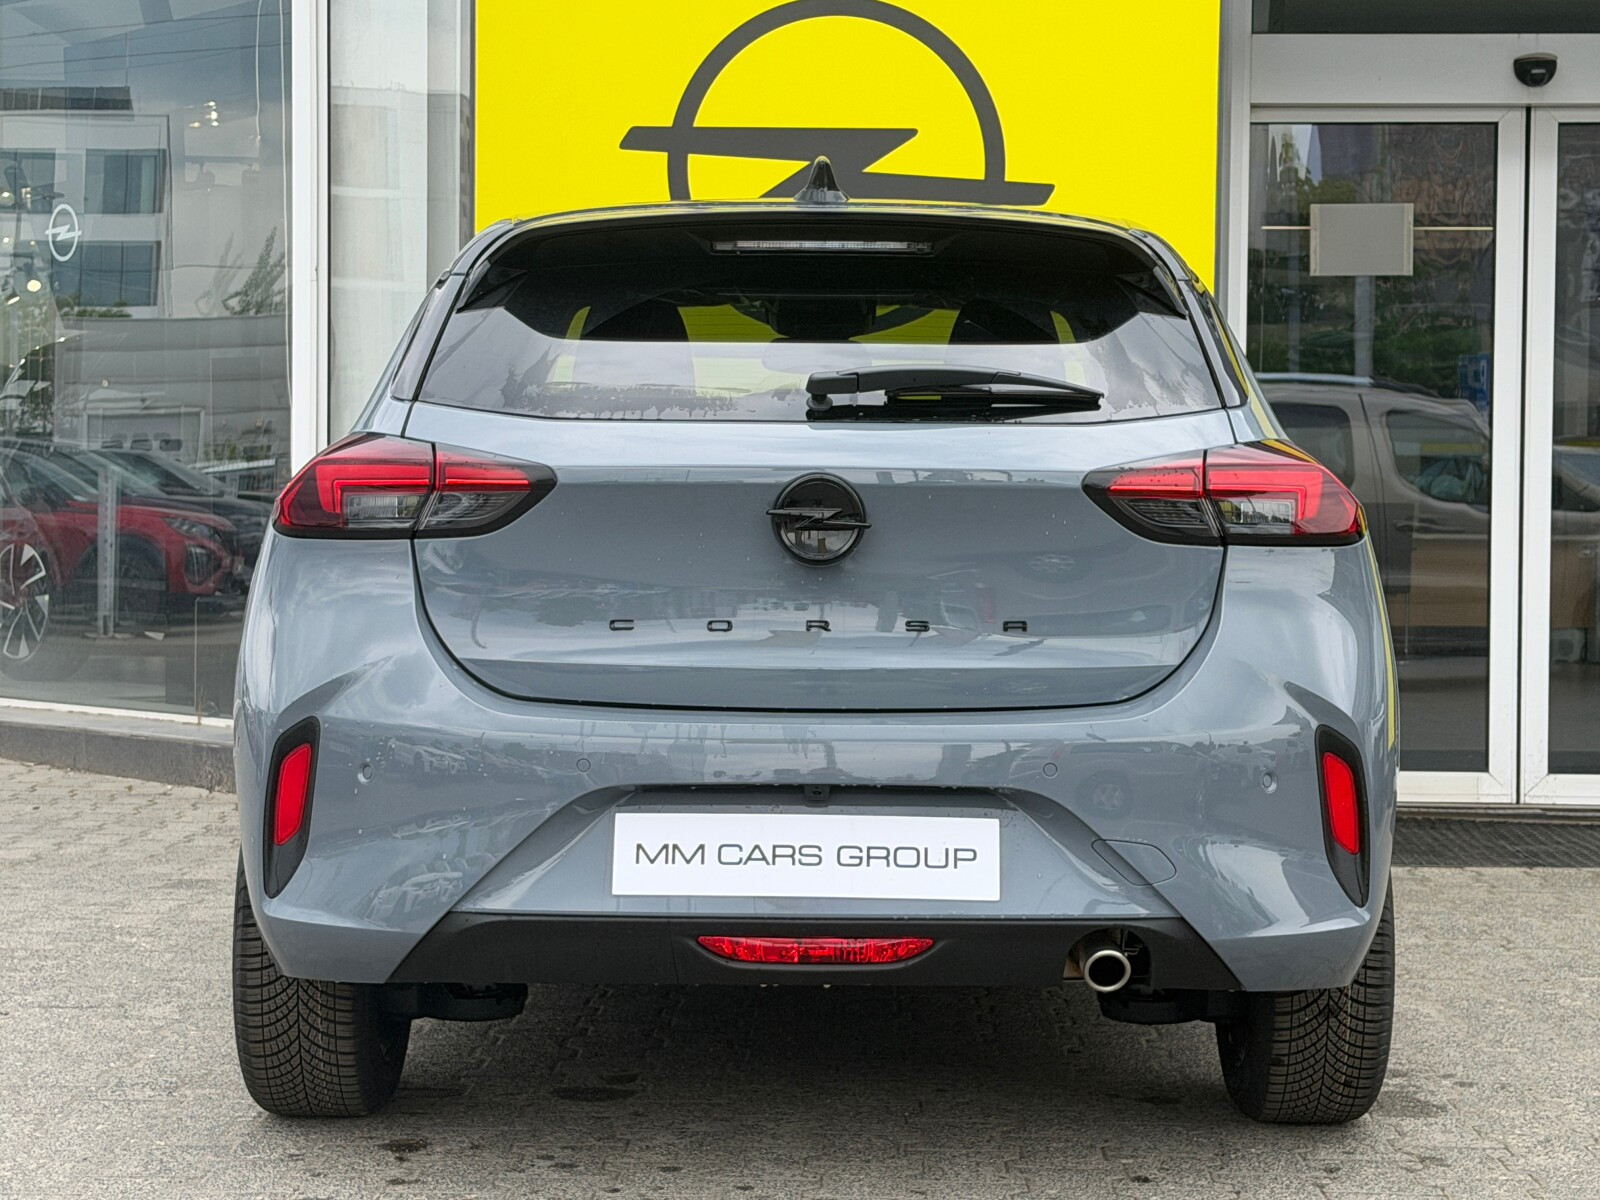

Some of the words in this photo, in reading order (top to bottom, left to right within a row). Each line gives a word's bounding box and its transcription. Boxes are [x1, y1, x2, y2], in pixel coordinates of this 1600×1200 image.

[609, 618, 1028, 632] CORSA
[635, 843, 706, 865] MM
[717, 844, 823, 866] CARS
[836, 845, 978, 869] GROUP
